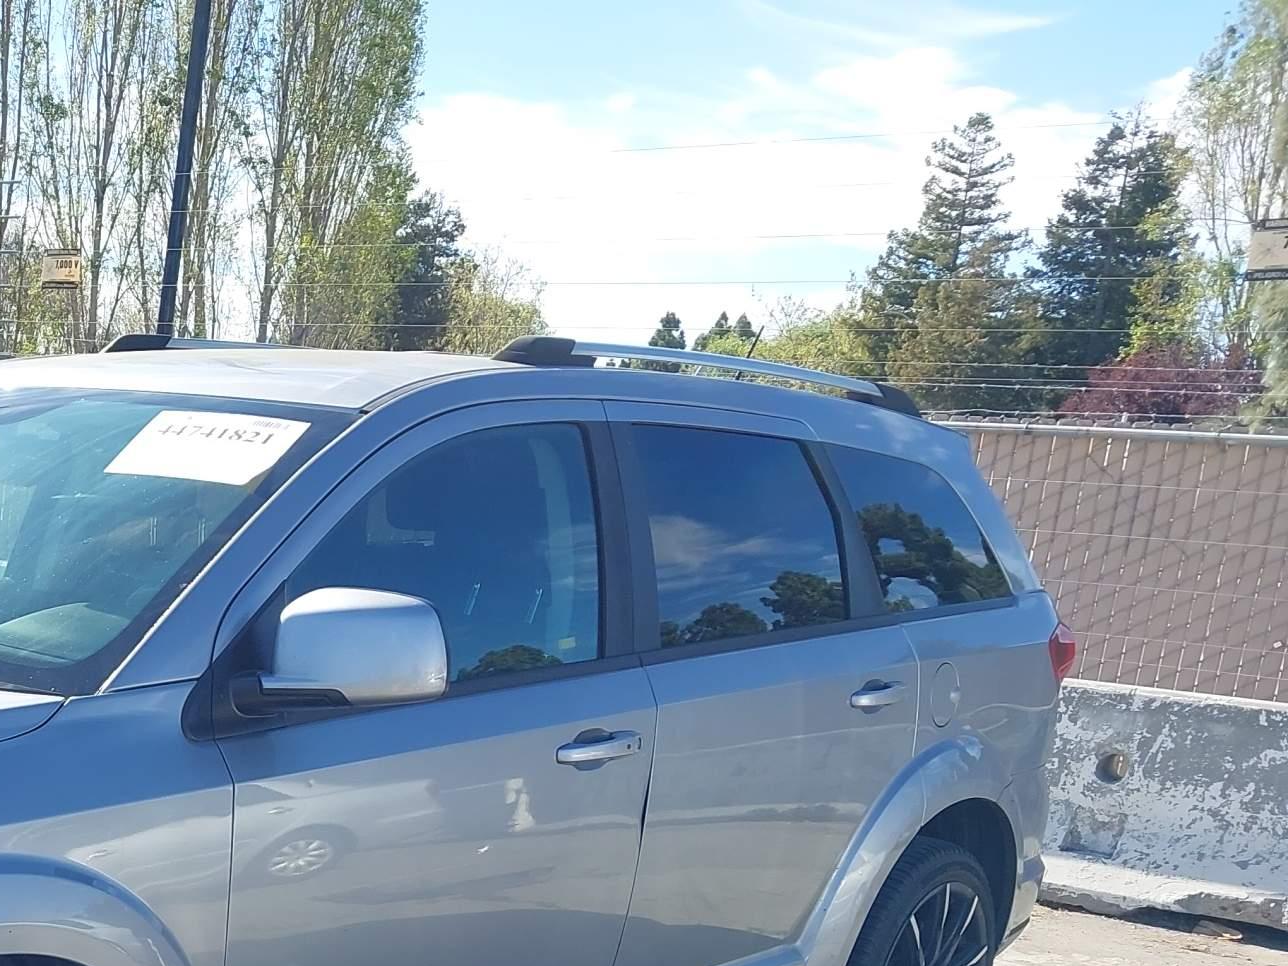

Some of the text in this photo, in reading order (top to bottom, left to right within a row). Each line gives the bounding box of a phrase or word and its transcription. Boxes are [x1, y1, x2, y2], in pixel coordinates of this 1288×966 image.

[55, 259, 79, 270] 7,000 V
[158, 424, 274, 444] 44741821
